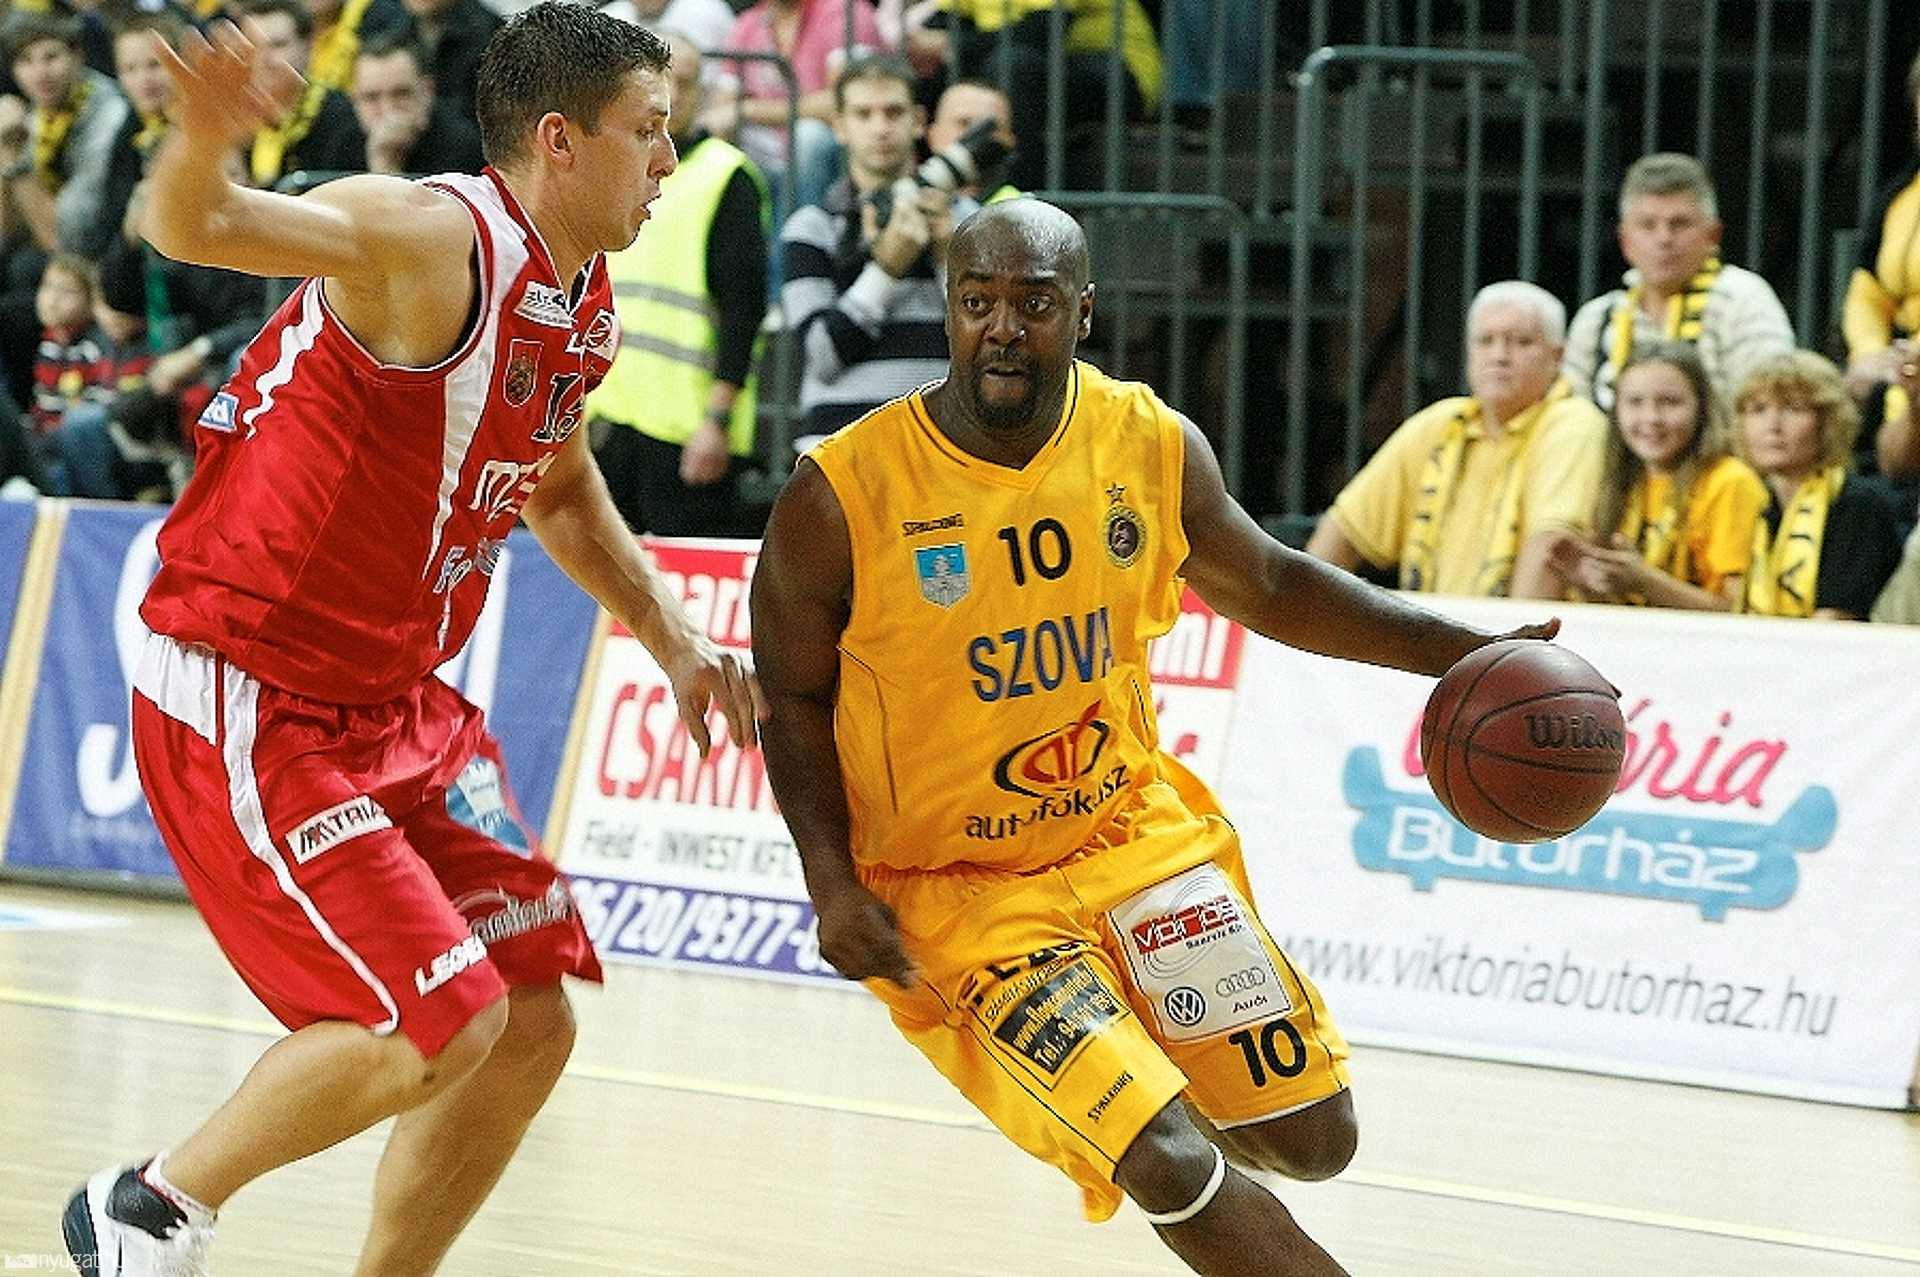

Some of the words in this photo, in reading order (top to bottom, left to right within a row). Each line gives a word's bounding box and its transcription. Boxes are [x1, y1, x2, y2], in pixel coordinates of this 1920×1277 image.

[999, 518, 1072, 587] 10
[969, 607, 1115, 702] SZOVA
[1229, 1018, 1307, 1088] 10
